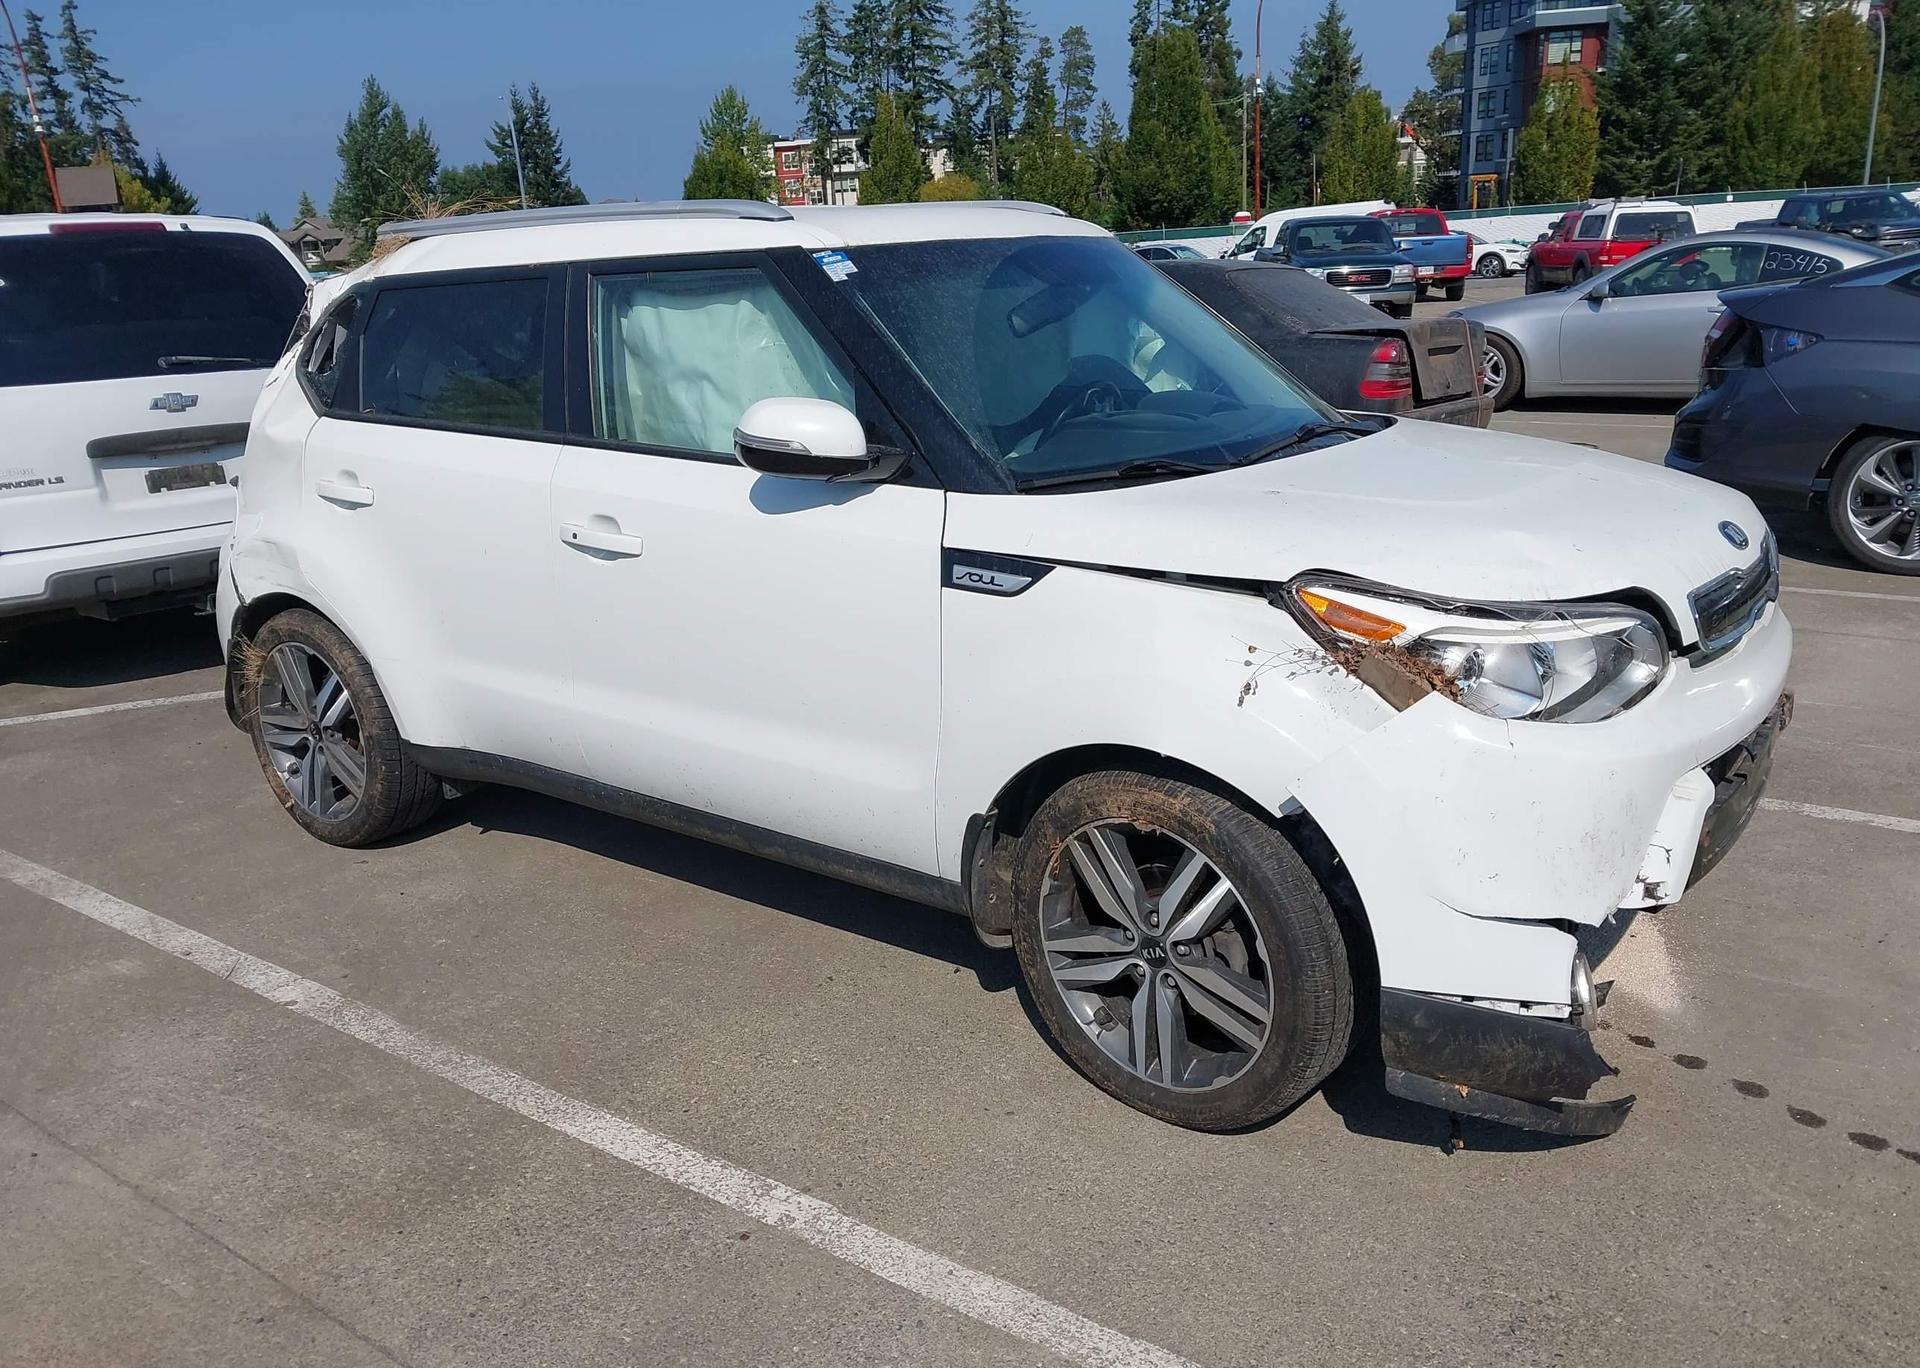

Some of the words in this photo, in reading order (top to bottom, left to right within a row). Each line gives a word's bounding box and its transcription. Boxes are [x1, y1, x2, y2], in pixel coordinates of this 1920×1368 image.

[1765, 251, 1831, 274] 23415
[1348, 274, 1372, 282] GMC
[48, 476, 65, 485] LS
[1141, 946, 1166, 960] KIA
